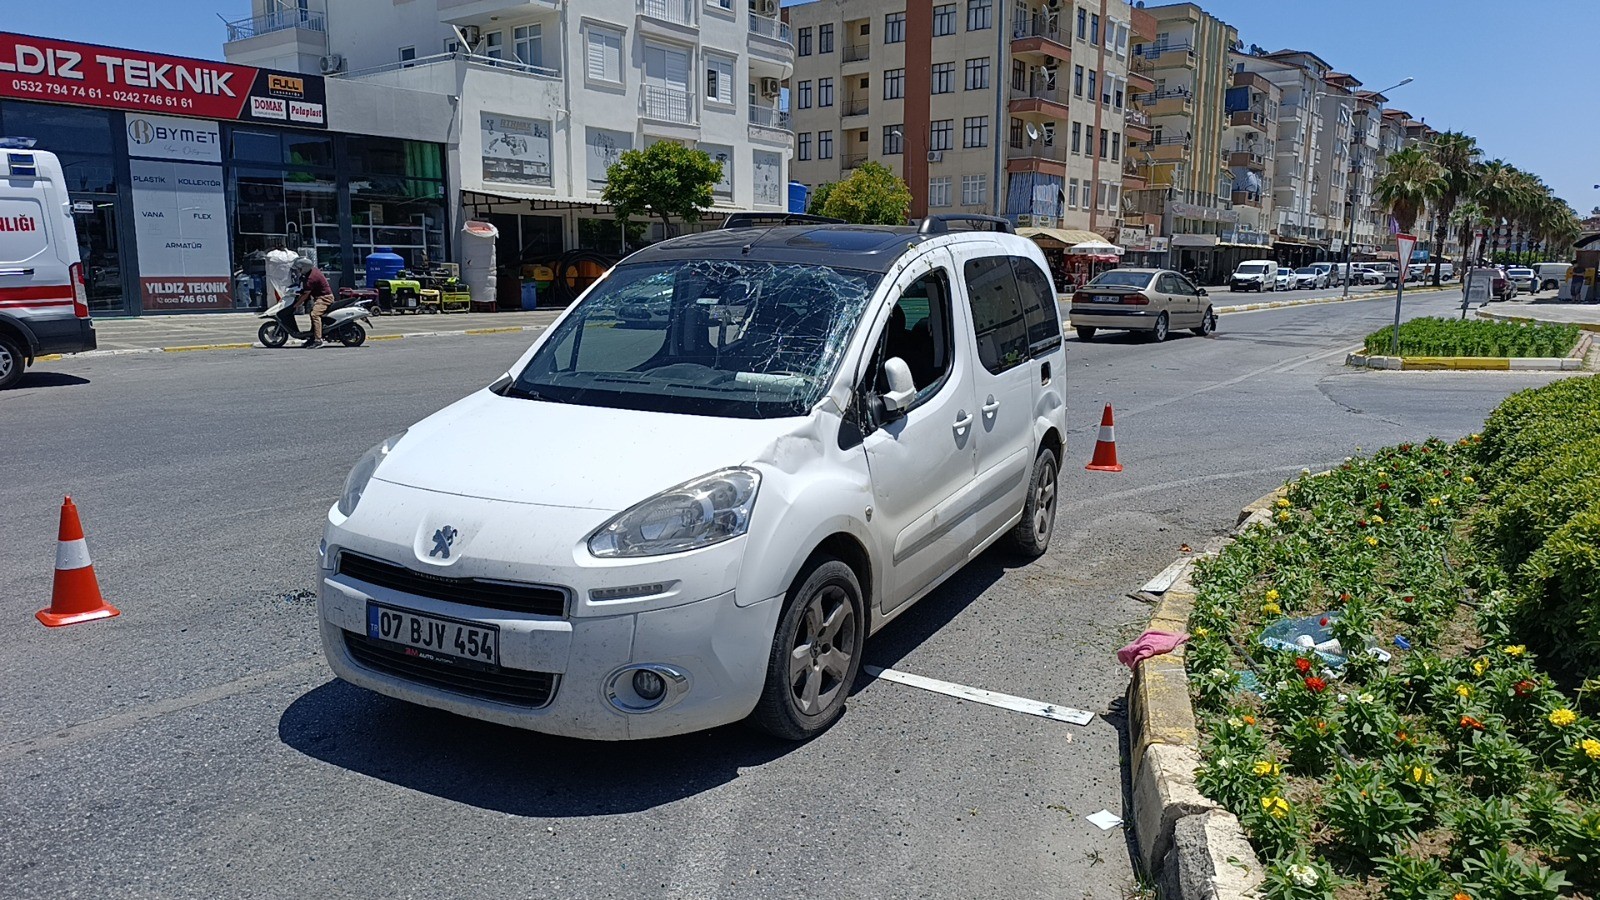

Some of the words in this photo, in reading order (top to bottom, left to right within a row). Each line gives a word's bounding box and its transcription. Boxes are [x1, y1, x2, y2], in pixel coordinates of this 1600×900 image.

[272, 79, 299, 90] FULL
[12, 79, 43, 93] 0532
[46, 83, 68, 96] 794
[71, 86, 86, 97] 74
[88, 88, 102, 98] 61
[113, 90, 140, 103] 0242
[143, 94, 163, 106] 746
[165, 96, 179, 107] 61
[181, 98, 193, 108] 61
[253, 99, 283, 112] DOMAK
[156, 126, 218, 144] BYMET
[133, 175, 166, 184] PLASTİK
[178, 178, 221, 187] KOLLEKTÖR
[145, 282, 186, 295] YILDIZ
[179, 295, 196, 304] 746
[196, 295, 207, 303] 61
[207, 294, 218, 303] 61
[370, 623, 379, 632] TR
[380, 611, 403, 638] 07
[410, 617, 446, 650] BJV
[454, 626, 493, 661] 454
